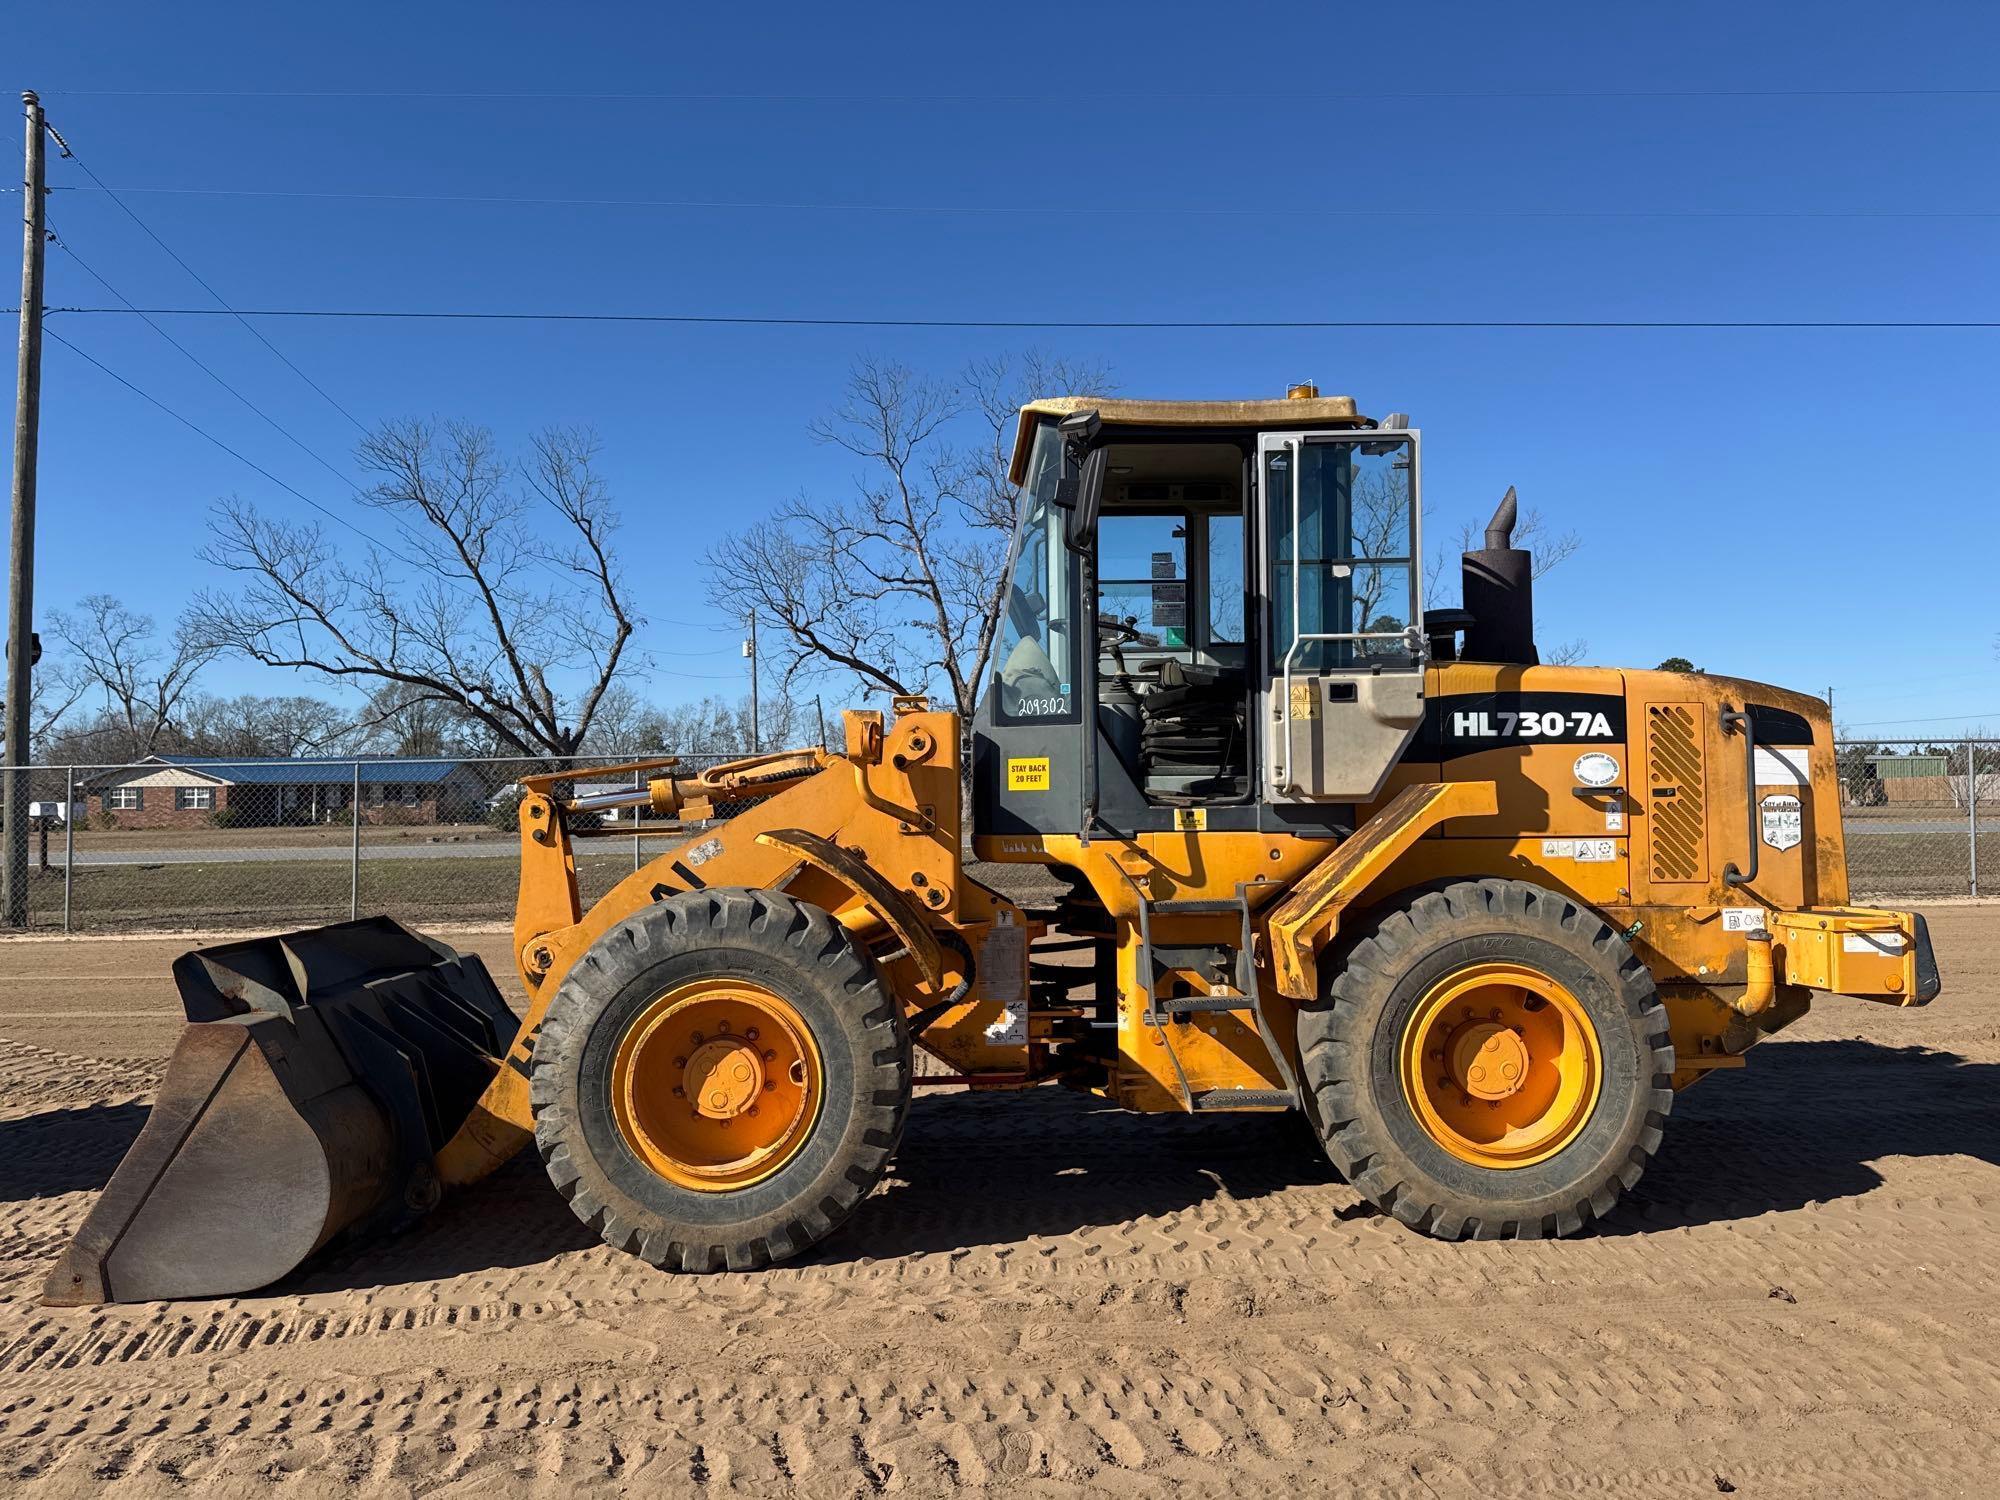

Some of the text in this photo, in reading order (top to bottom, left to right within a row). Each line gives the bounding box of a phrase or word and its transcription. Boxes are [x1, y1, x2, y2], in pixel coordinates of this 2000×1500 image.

[1018, 697, 1068, 716] 209302
[1453, 712, 1614, 737] HL730-7A
[1028, 764, 1047, 772] BACK
